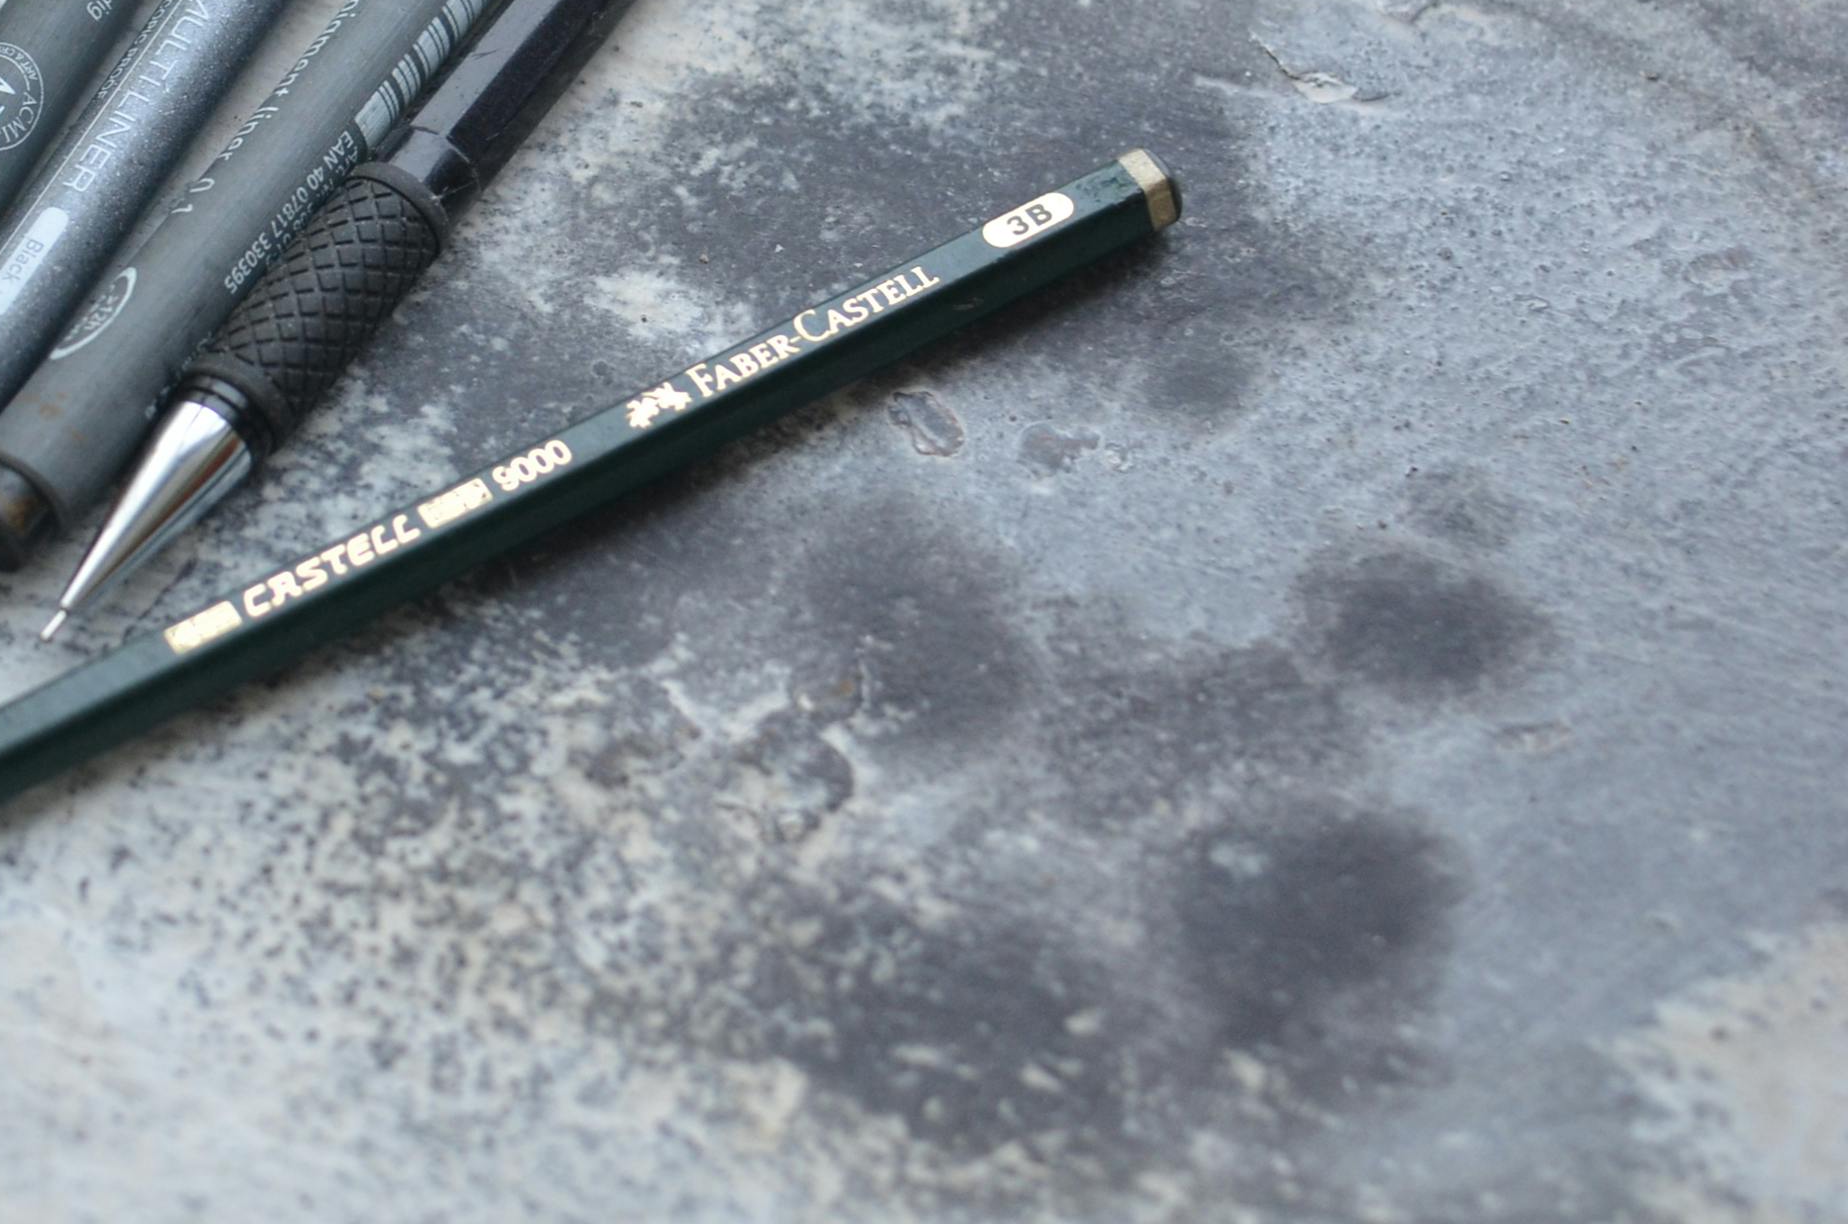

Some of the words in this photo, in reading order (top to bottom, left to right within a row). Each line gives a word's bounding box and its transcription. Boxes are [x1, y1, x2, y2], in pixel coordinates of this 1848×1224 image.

[2, 91, 37, 143] ACMI
[320, 128, 357, 169] EAN
[302, 162, 329, 191] 40
[267, 182, 312, 236] 07817
[1005, 203, 1053, 237] 3B
[0, 234, 45, 288] Black
[219, 229, 274, 295] 330395
[685, 265, 940, 399] FABER-CASTELL
[242, 513, 423, 619] CASTELL
[492, 439, 573, 490] 9000
